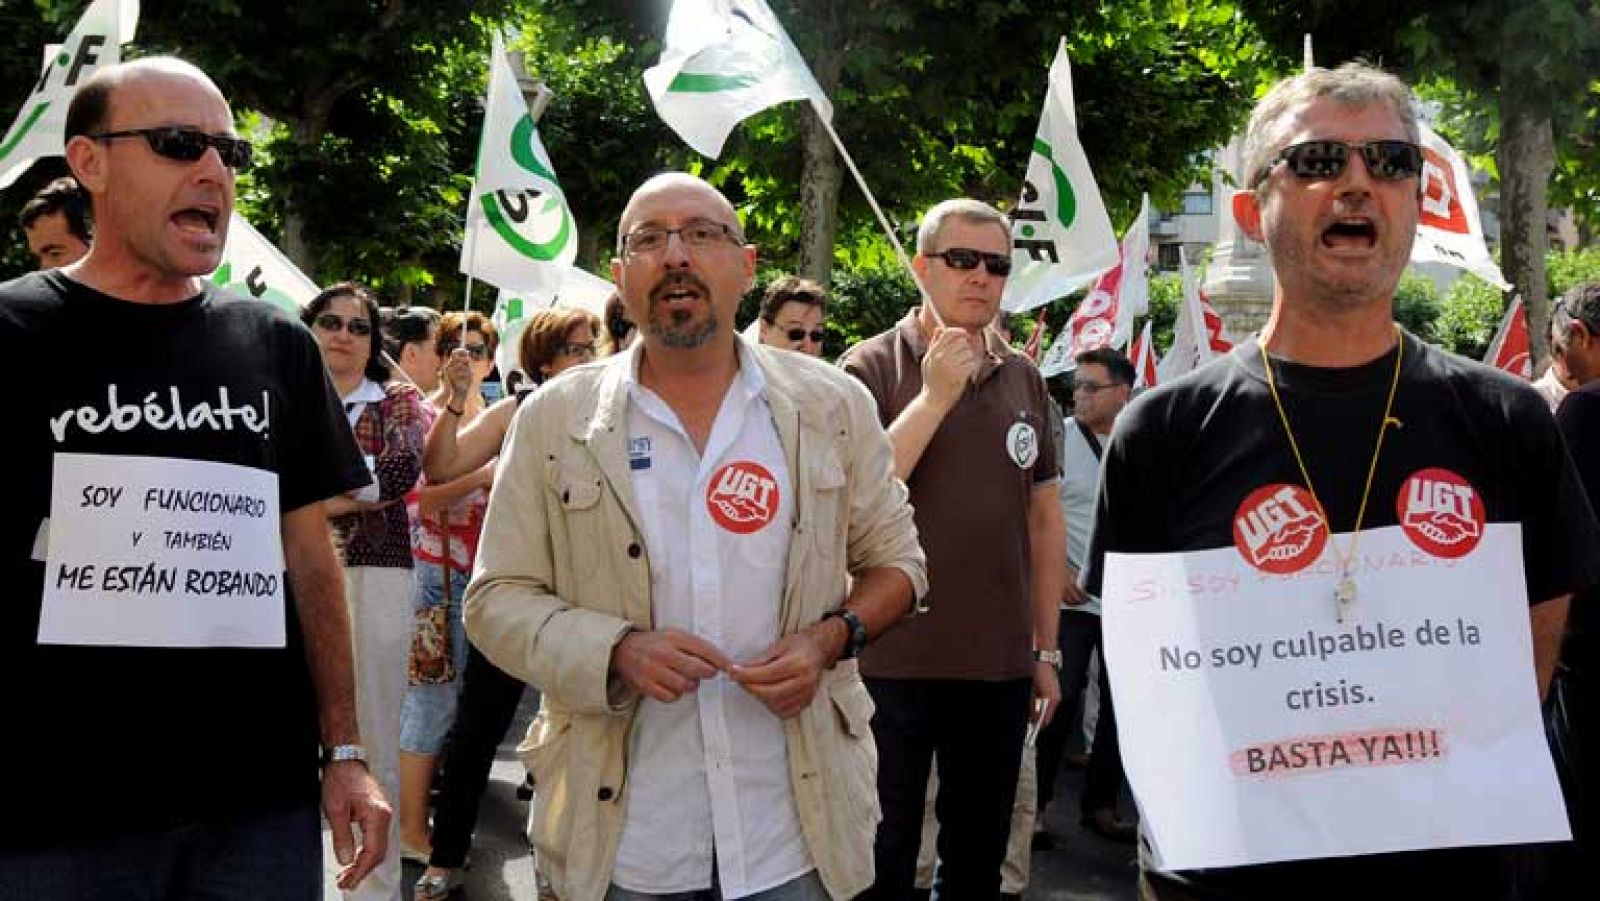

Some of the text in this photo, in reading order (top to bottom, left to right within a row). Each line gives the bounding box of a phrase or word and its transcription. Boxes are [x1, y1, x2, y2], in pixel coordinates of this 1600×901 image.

[50, 383, 270, 443] rebélate!
[80, 485, 267, 518] SOY FUNCIONARIO
[718, 466, 775, 508] UGT
[1405, 477, 1474, 523] UGT
[1237, 485, 1308, 551] UGT
[132, 531, 232, 551] Y TAMBIÉN
[56, 560, 278, 598] ME ESTÁN ROBANDO
[1160, 617, 1481, 671] No soy culpable de la
[1286, 679, 1375, 710] crisis.
[1247, 730, 1441, 773] BASTA YA!!!
